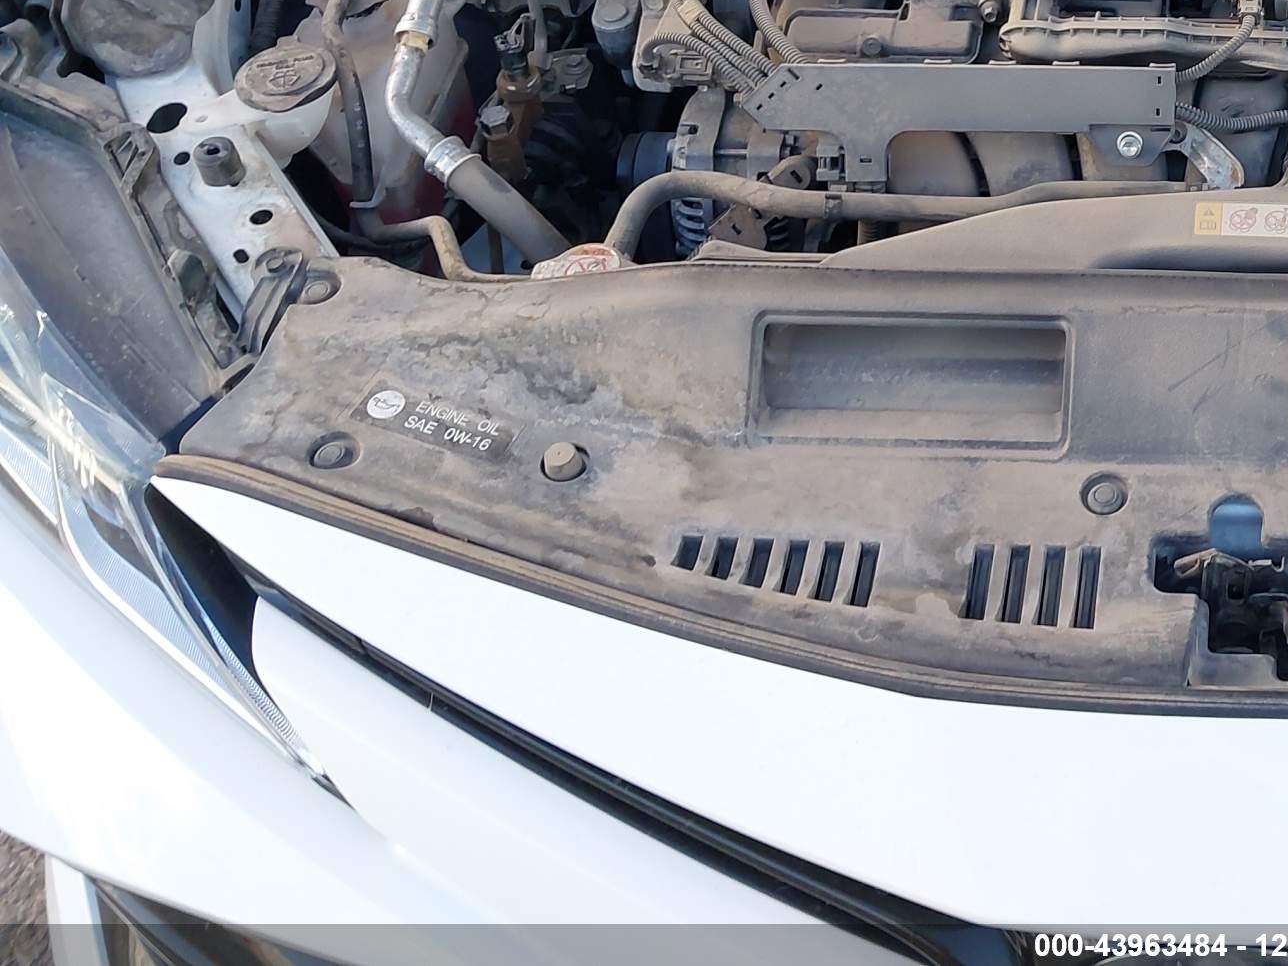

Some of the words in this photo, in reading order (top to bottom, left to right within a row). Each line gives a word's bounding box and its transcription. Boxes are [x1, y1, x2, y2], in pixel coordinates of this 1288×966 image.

[404, 415, 438, 434] SAE
[443, 427, 493, 451] 0W-16
[415, 400, 469, 427] ENGINE
[477, 419, 501, 436] OIL
